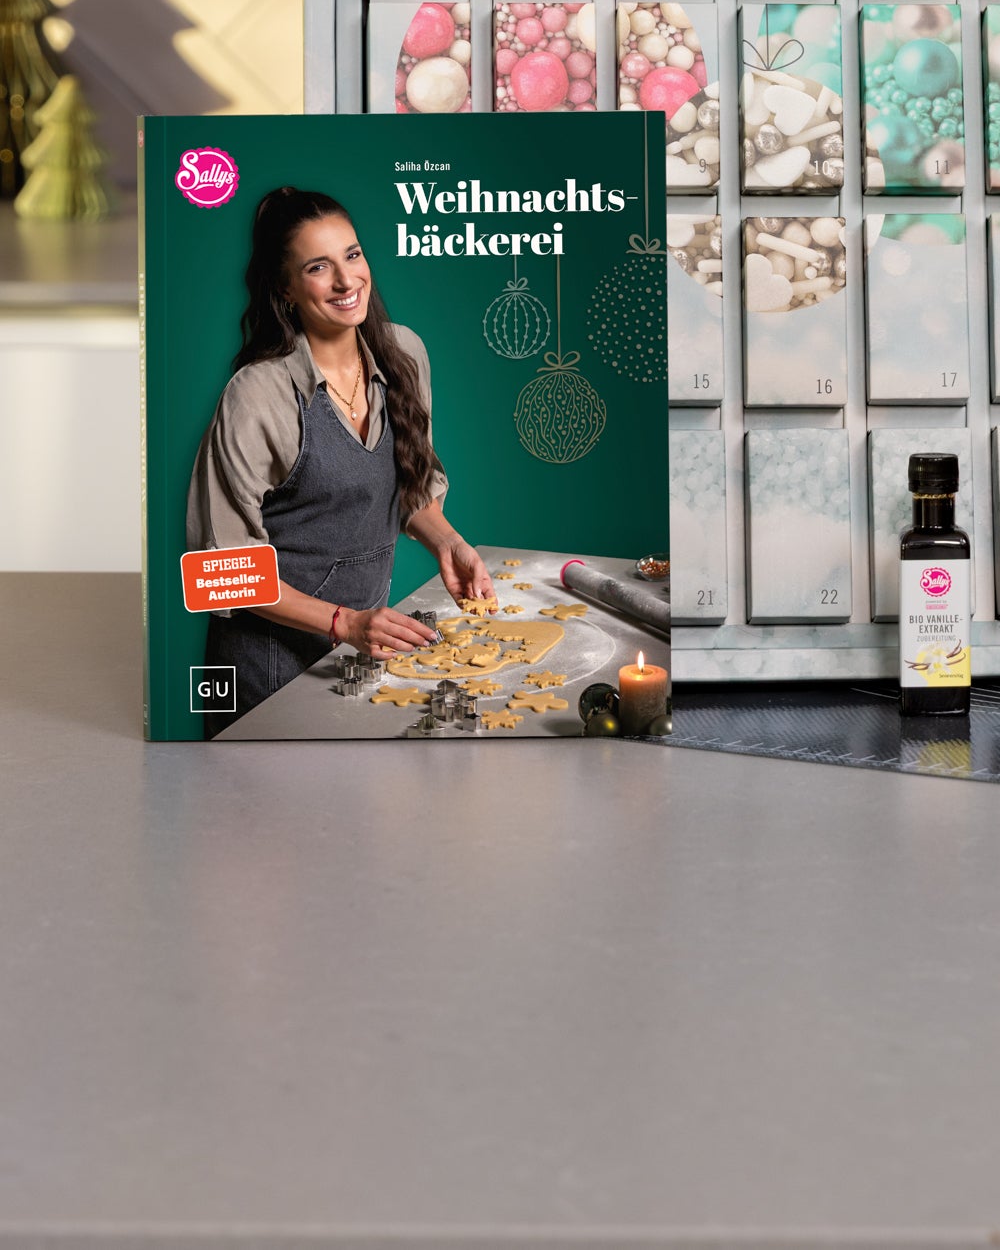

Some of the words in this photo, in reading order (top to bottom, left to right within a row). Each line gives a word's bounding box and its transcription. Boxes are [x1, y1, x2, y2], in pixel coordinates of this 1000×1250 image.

[177, 151, 236, 191] Sallys
[394, 161, 422, 172] Saliha
[424, 159, 451, 172] Özcan
[699, 158, 707, 173] 9
[813, 160, 831, 175] 10
[935, 160, 951, 175] 11
[394, 178, 639, 215] Weihnachts-
[396, 222, 565, 257] bäckerei
[693, 373, 710, 389] 15
[816, 379, 833, 394] 16
[941, 372, 958, 388] 17
[202, 556, 256, 573] SPIEGEL
[196, 573, 266, 589] Bestseller-
[208, 587, 256, 601] Autorin
[697, 590, 714, 605] 21
[820, 589, 838, 604] 22
[909, 614, 924, 624] BIO
[926, 614, 964, 624] VANILLE-
[919, 624, 954, 634] EXTRAKT
